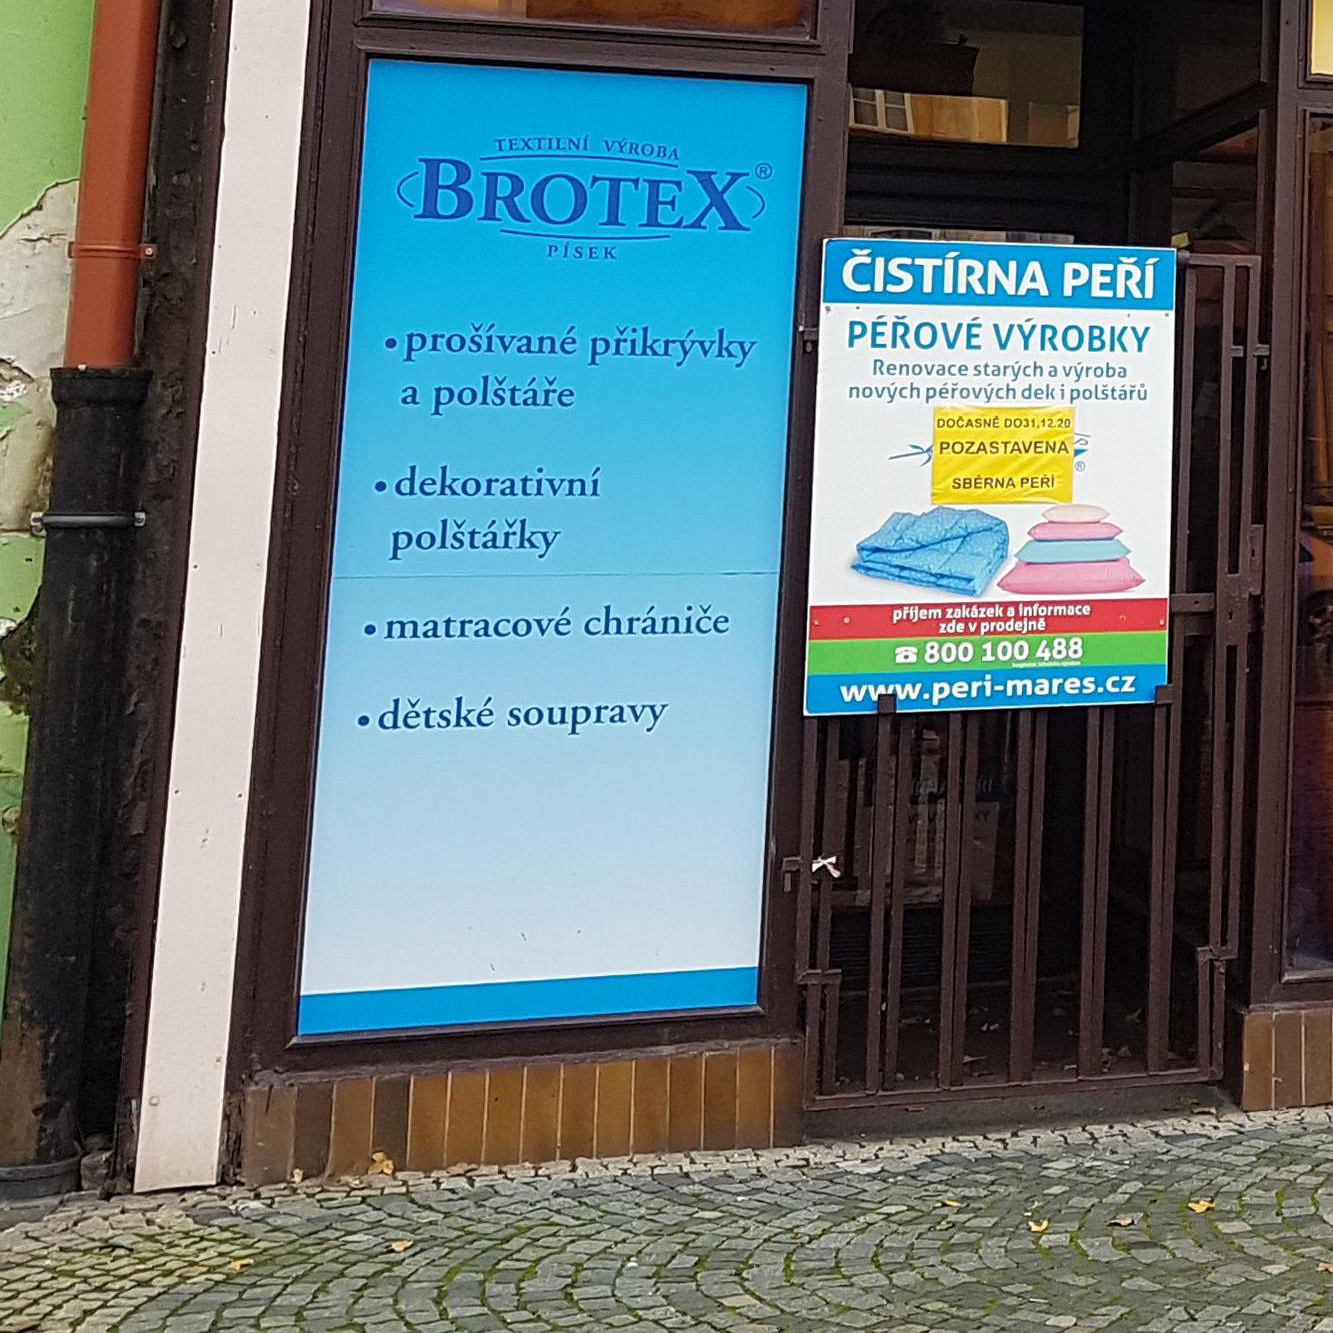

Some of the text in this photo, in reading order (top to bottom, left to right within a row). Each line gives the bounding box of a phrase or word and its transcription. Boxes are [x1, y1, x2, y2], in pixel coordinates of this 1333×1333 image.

[495, 135, 680, 161] TEXTILNÍ VÝROBA
[413, 157, 751, 232] BROTEX
[547, 242, 618, 261] PÍSEK
[842, 248, 1160, 300] ČISTÍRNA PEŘÍ
[402, 322, 757, 368] prošívané přikrývky
[848, 314, 1151, 353] PÉŘOVÉ VÝROBKY
[872, 360, 1127, 382] Renovace starých a výroba
[401, 375, 576, 415] a polštáře
[848, 382, 1148, 404] nových péřových dek i polštářů
[937, 416, 999, 428] DOČASNĚ
[939, 441, 1069, 455] POZASTAVENA
[395, 466, 600, 498] dekorativní
[952, 474, 1055, 489] SBĚRNA PEŘÍ
[389, 519, 561, 561] polštářky
[383, 604, 730, 640] matracové chrániče
[892, 603, 1091, 623] příjem zakázek a informace
[938, 618, 1046, 636] zde v prodejně
[924, 637, 1083, 664] 800 100 488
[840, 673, 1136, 706] www.peri-mares.cz
[377, 697, 669, 735] dětské soupravy
